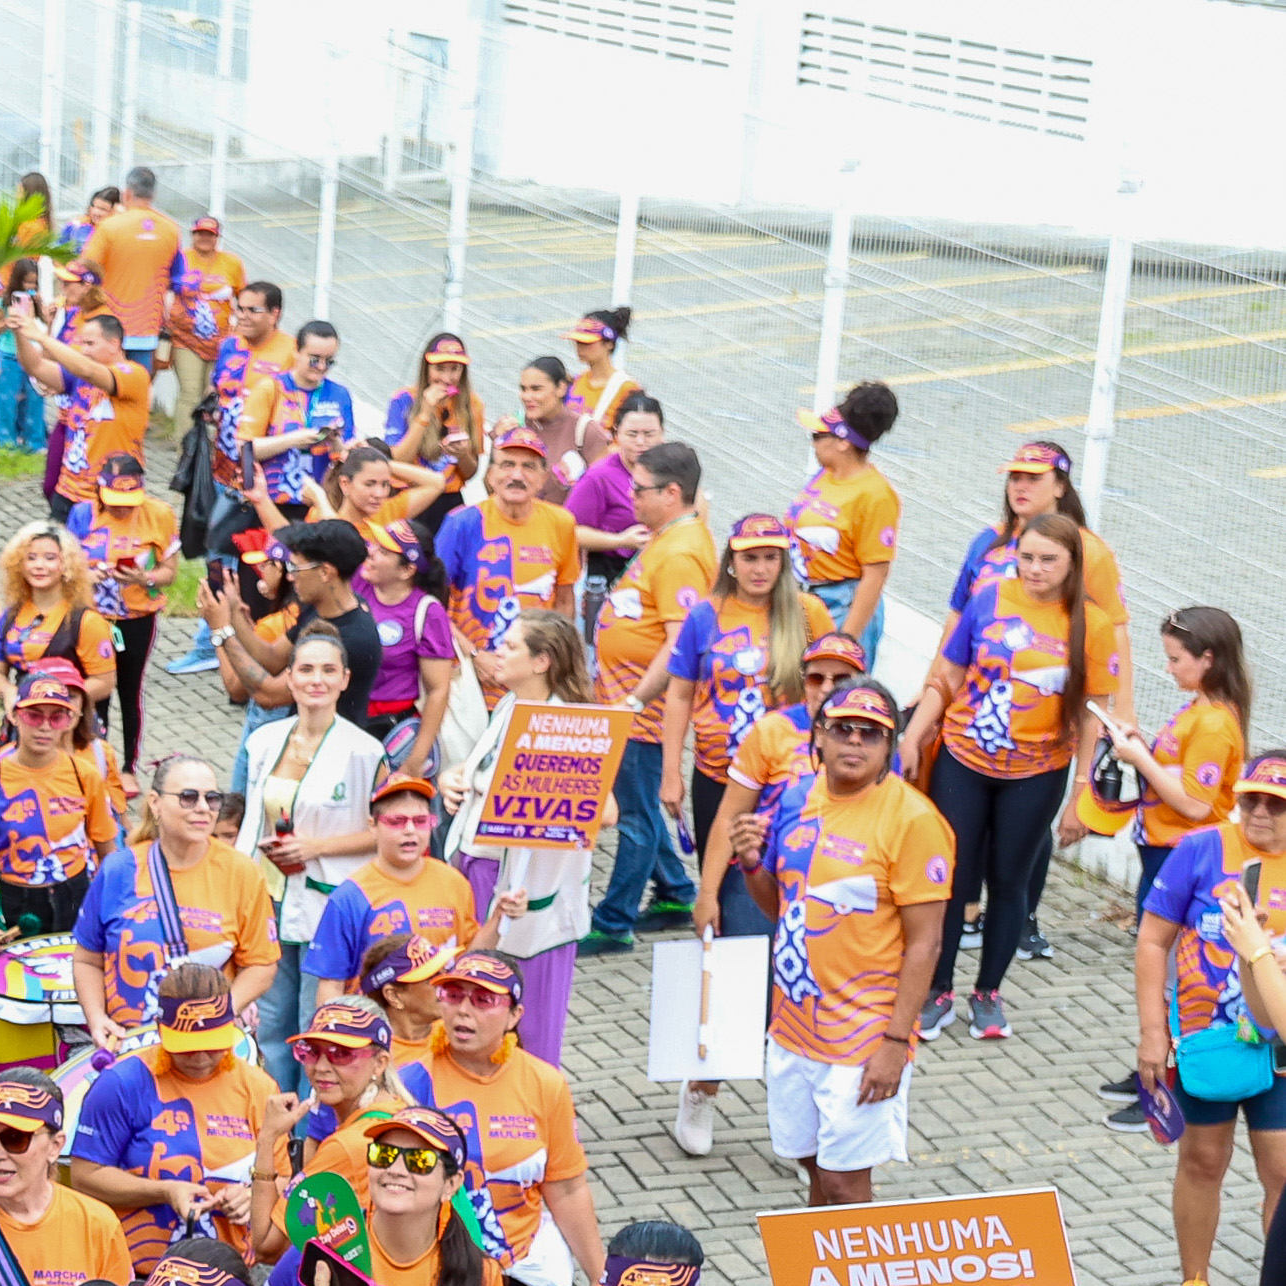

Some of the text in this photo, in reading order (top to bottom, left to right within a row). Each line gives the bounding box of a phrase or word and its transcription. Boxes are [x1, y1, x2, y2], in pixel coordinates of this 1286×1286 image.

[528, 713, 610, 736] NENHUMA
[515, 733, 612, 754] A MENOS!
[513, 753, 603, 775] QUEREMOS
[501, 774, 603, 796] AS MULHERES
[493, 795, 598, 822] VIVAS
[813, 1215, 1012, 1261] NENHUMA
